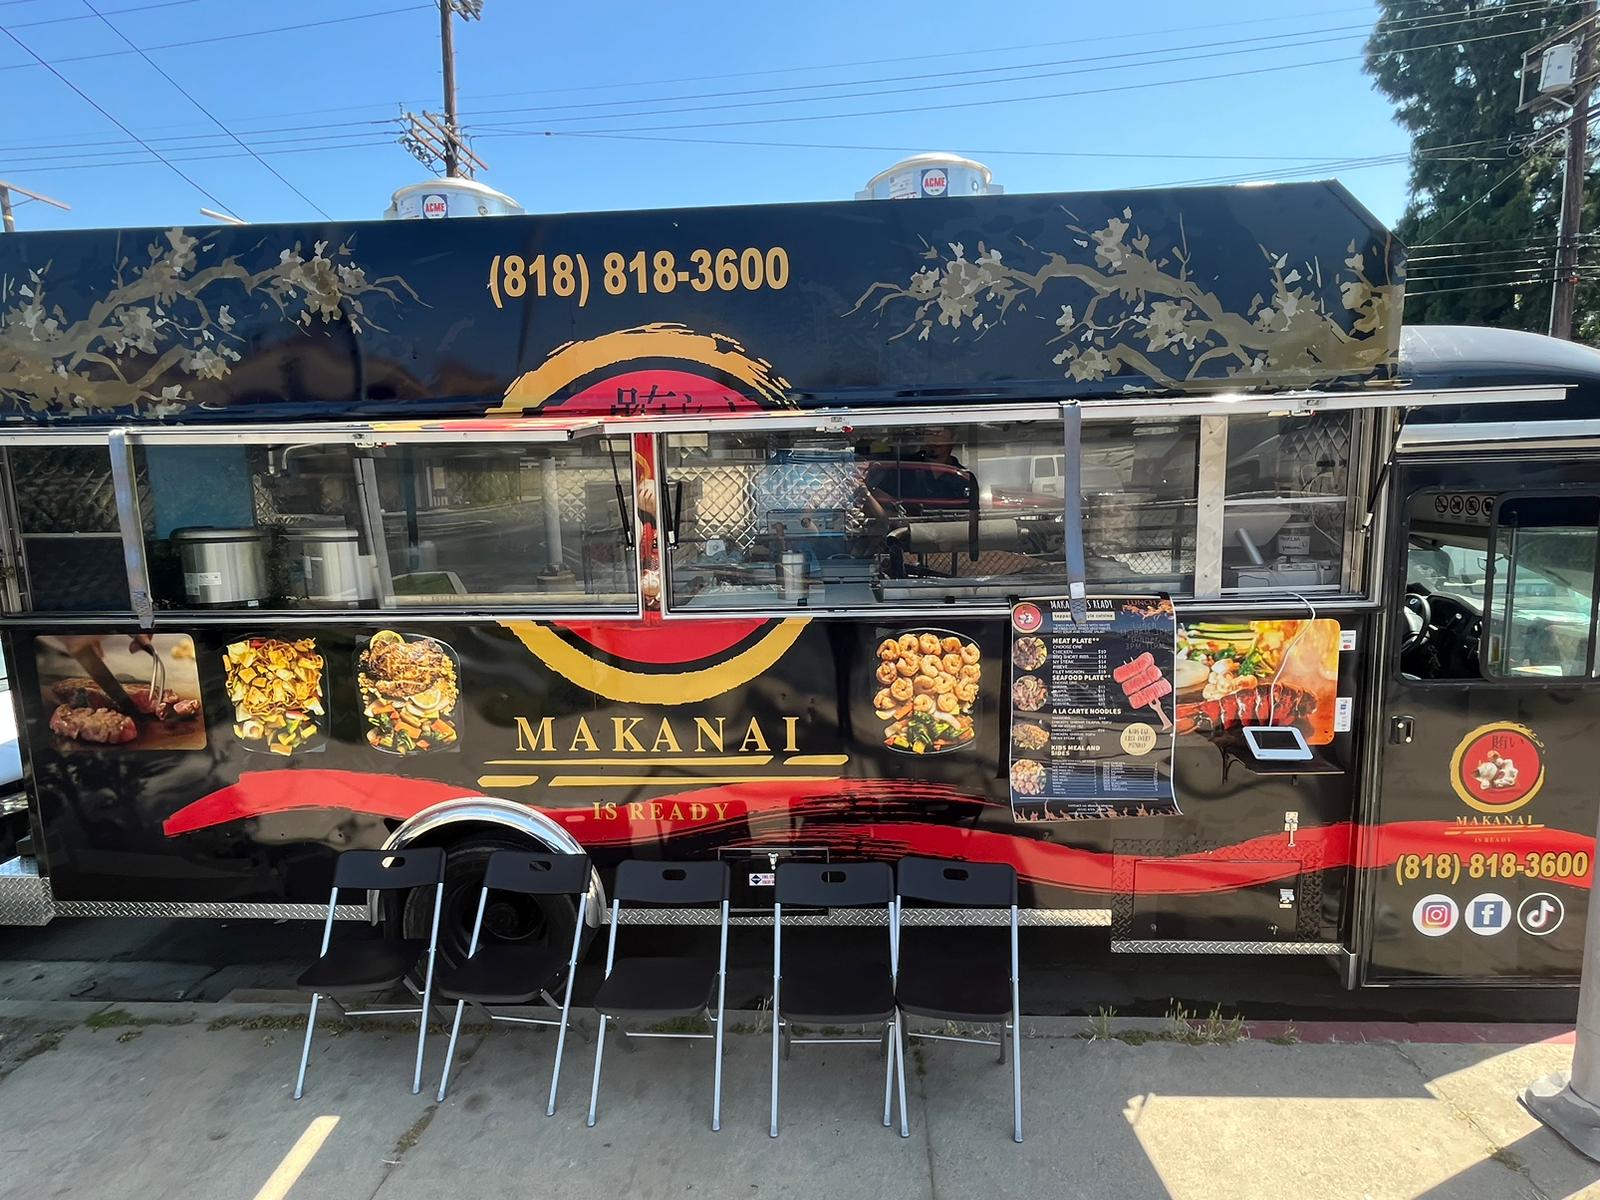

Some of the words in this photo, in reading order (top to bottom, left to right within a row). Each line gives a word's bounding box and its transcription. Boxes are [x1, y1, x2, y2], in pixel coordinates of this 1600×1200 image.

[924, 177, 945, 188] ACME
[425, 202, 445, 213] ACME
[489, 253, 590, 309] (818)
[603, 246, 789, 295] 818-3600
[1093, 600, 1113, 609] READY
[514, 716, 801, 752] MAKANAI
[592, 802, 618, 820] IS
[628, 802, 729, 820] READY
[1456, 815, 1533, 825] MAKANAI
[1396, 853, 1461, 885] (818)
[1469, 851, 1588, 878] 818-3600
